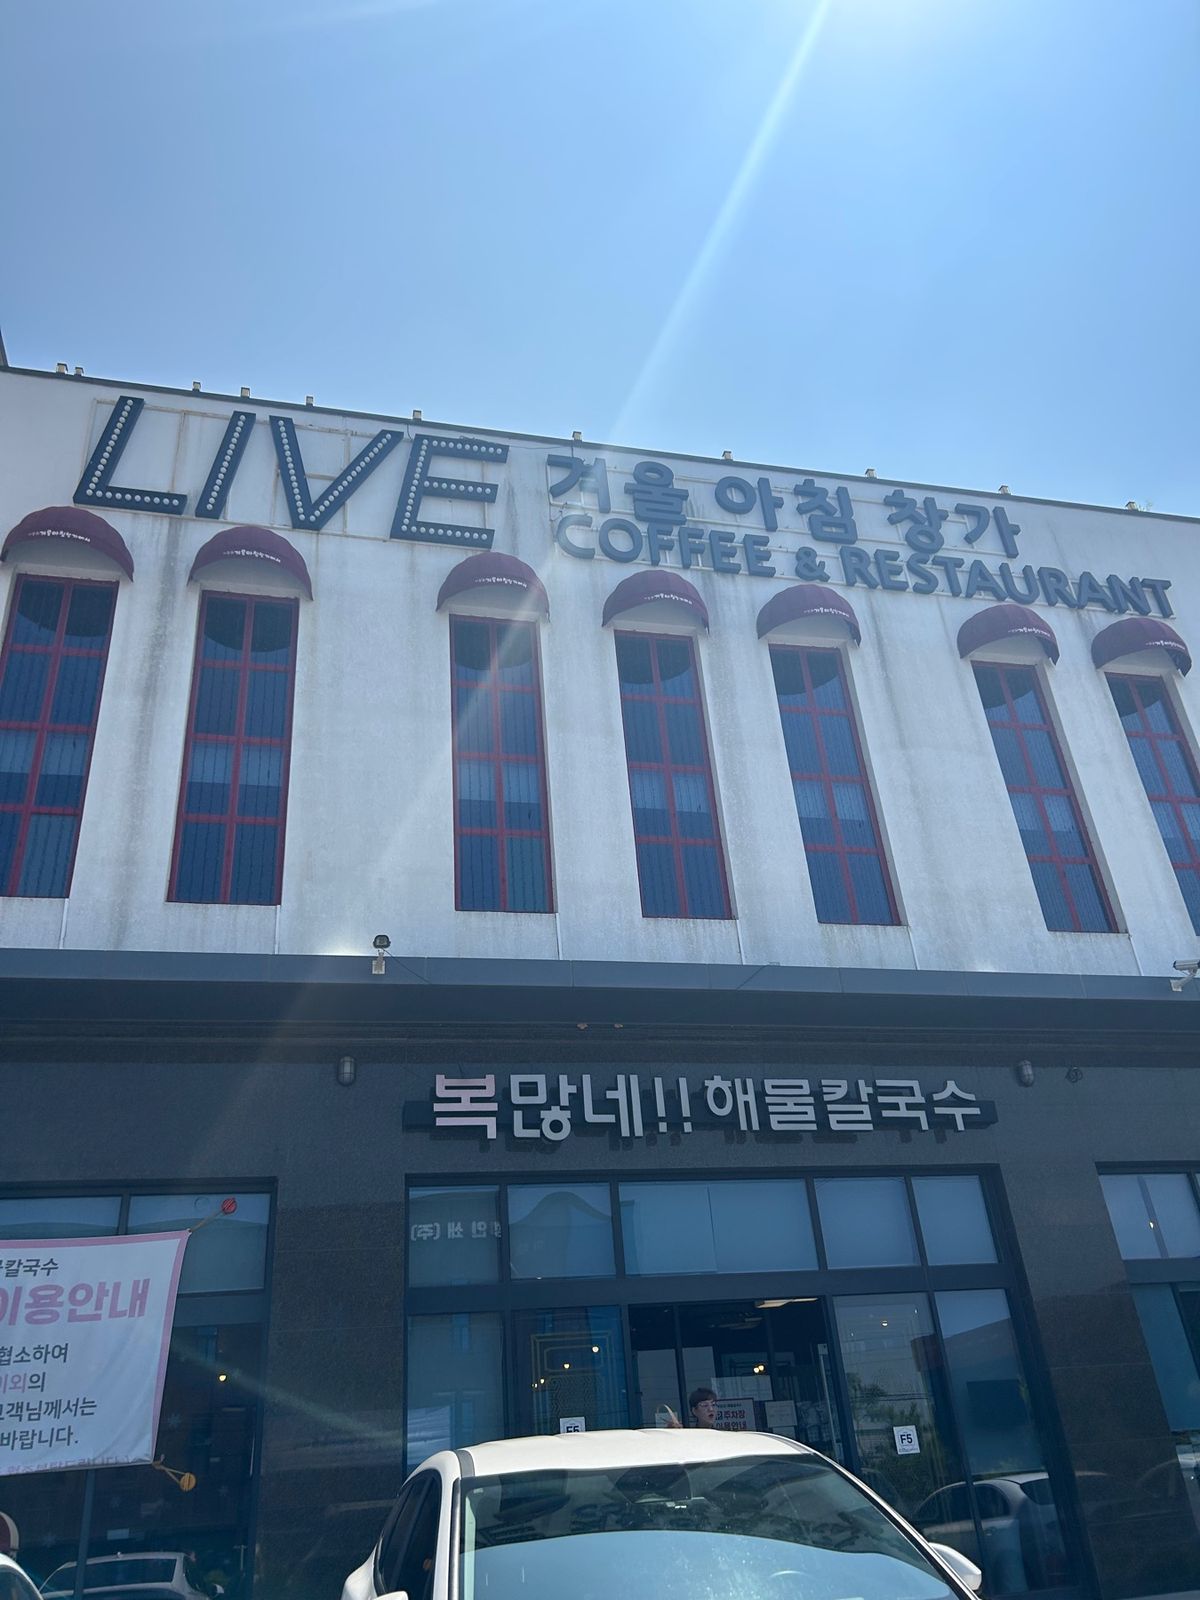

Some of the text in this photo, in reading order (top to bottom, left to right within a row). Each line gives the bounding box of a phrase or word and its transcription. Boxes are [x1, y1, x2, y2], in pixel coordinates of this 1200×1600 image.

[73, 395, 509, 549] LIVE
[546, 454, 1020, 558] 겨울 아침 창가
[557, 514, 1174, 619] COFFEE & RESTAURANT
[0, 1258, 59, 1278] 칼국수
[0, 1343, 69, 1367] 협소하여
[0, 1425, 79, 1451] 바랍니다.
[900, 1434, 913, 1444] F5
